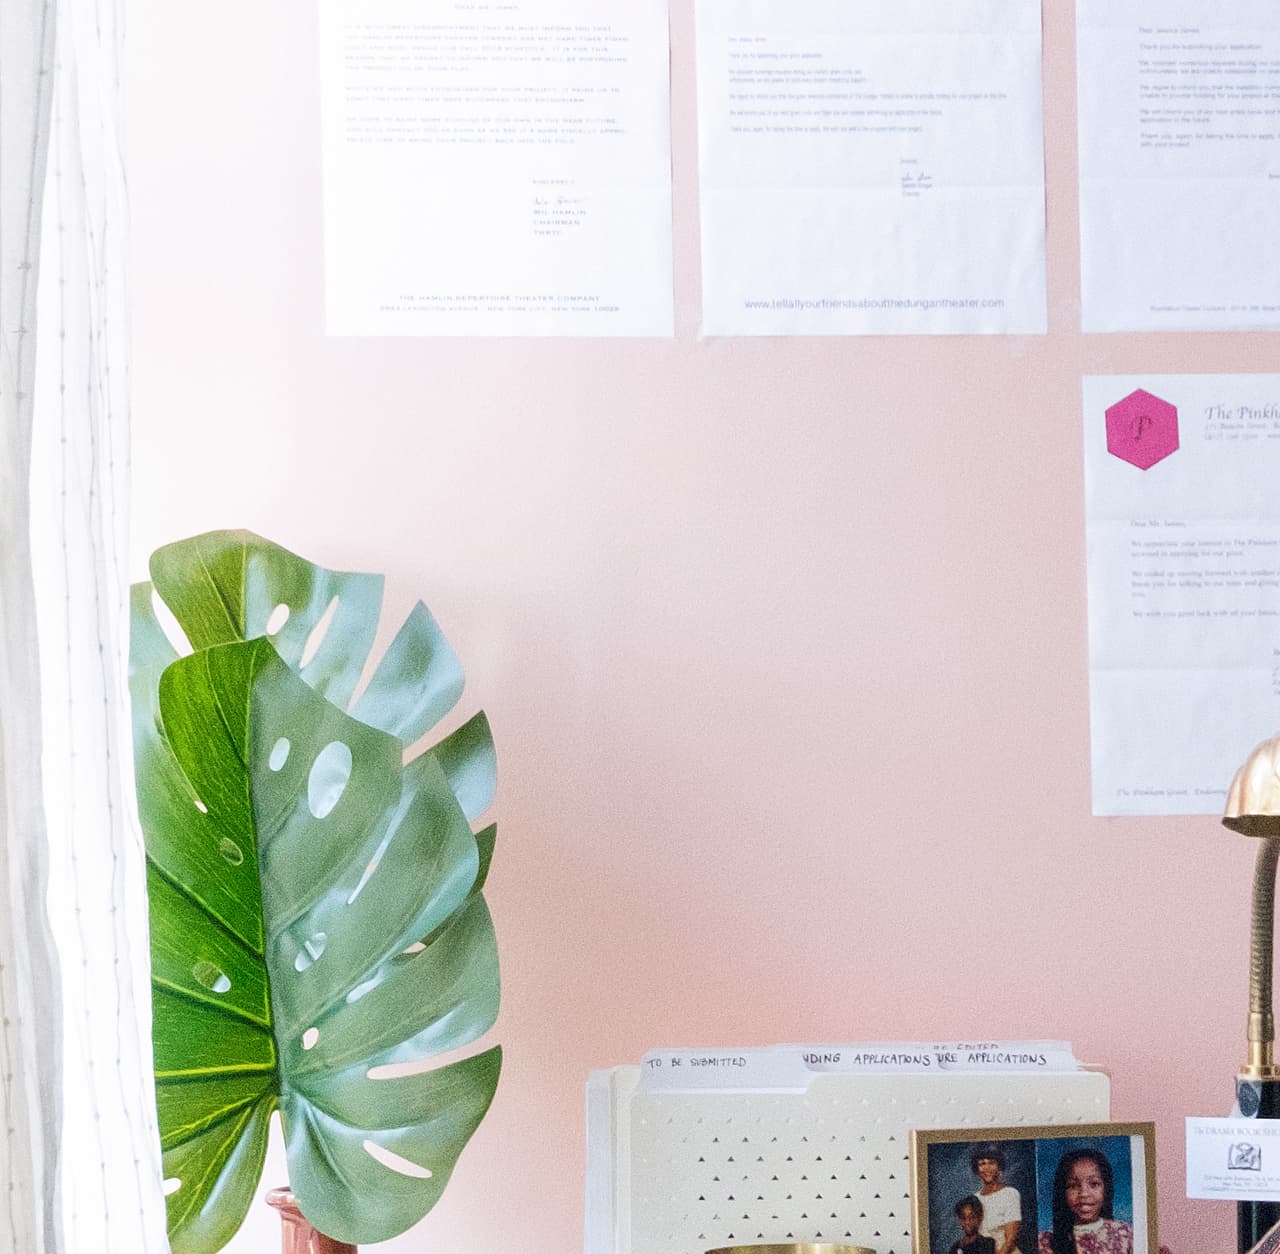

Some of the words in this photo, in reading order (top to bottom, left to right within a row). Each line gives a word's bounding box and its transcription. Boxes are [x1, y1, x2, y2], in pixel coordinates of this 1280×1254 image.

[1204, 403, 1233, 421] The
[646, 1058, 663, 1068] TO
[671, 1056, 683, 1068] BE
[689, 1056, 748, 1068] SUBMITTED
[852, 1052, 932, 1067] APPLICATIONS
[966, 1052, 1048, 1067] APPLICATIONS
